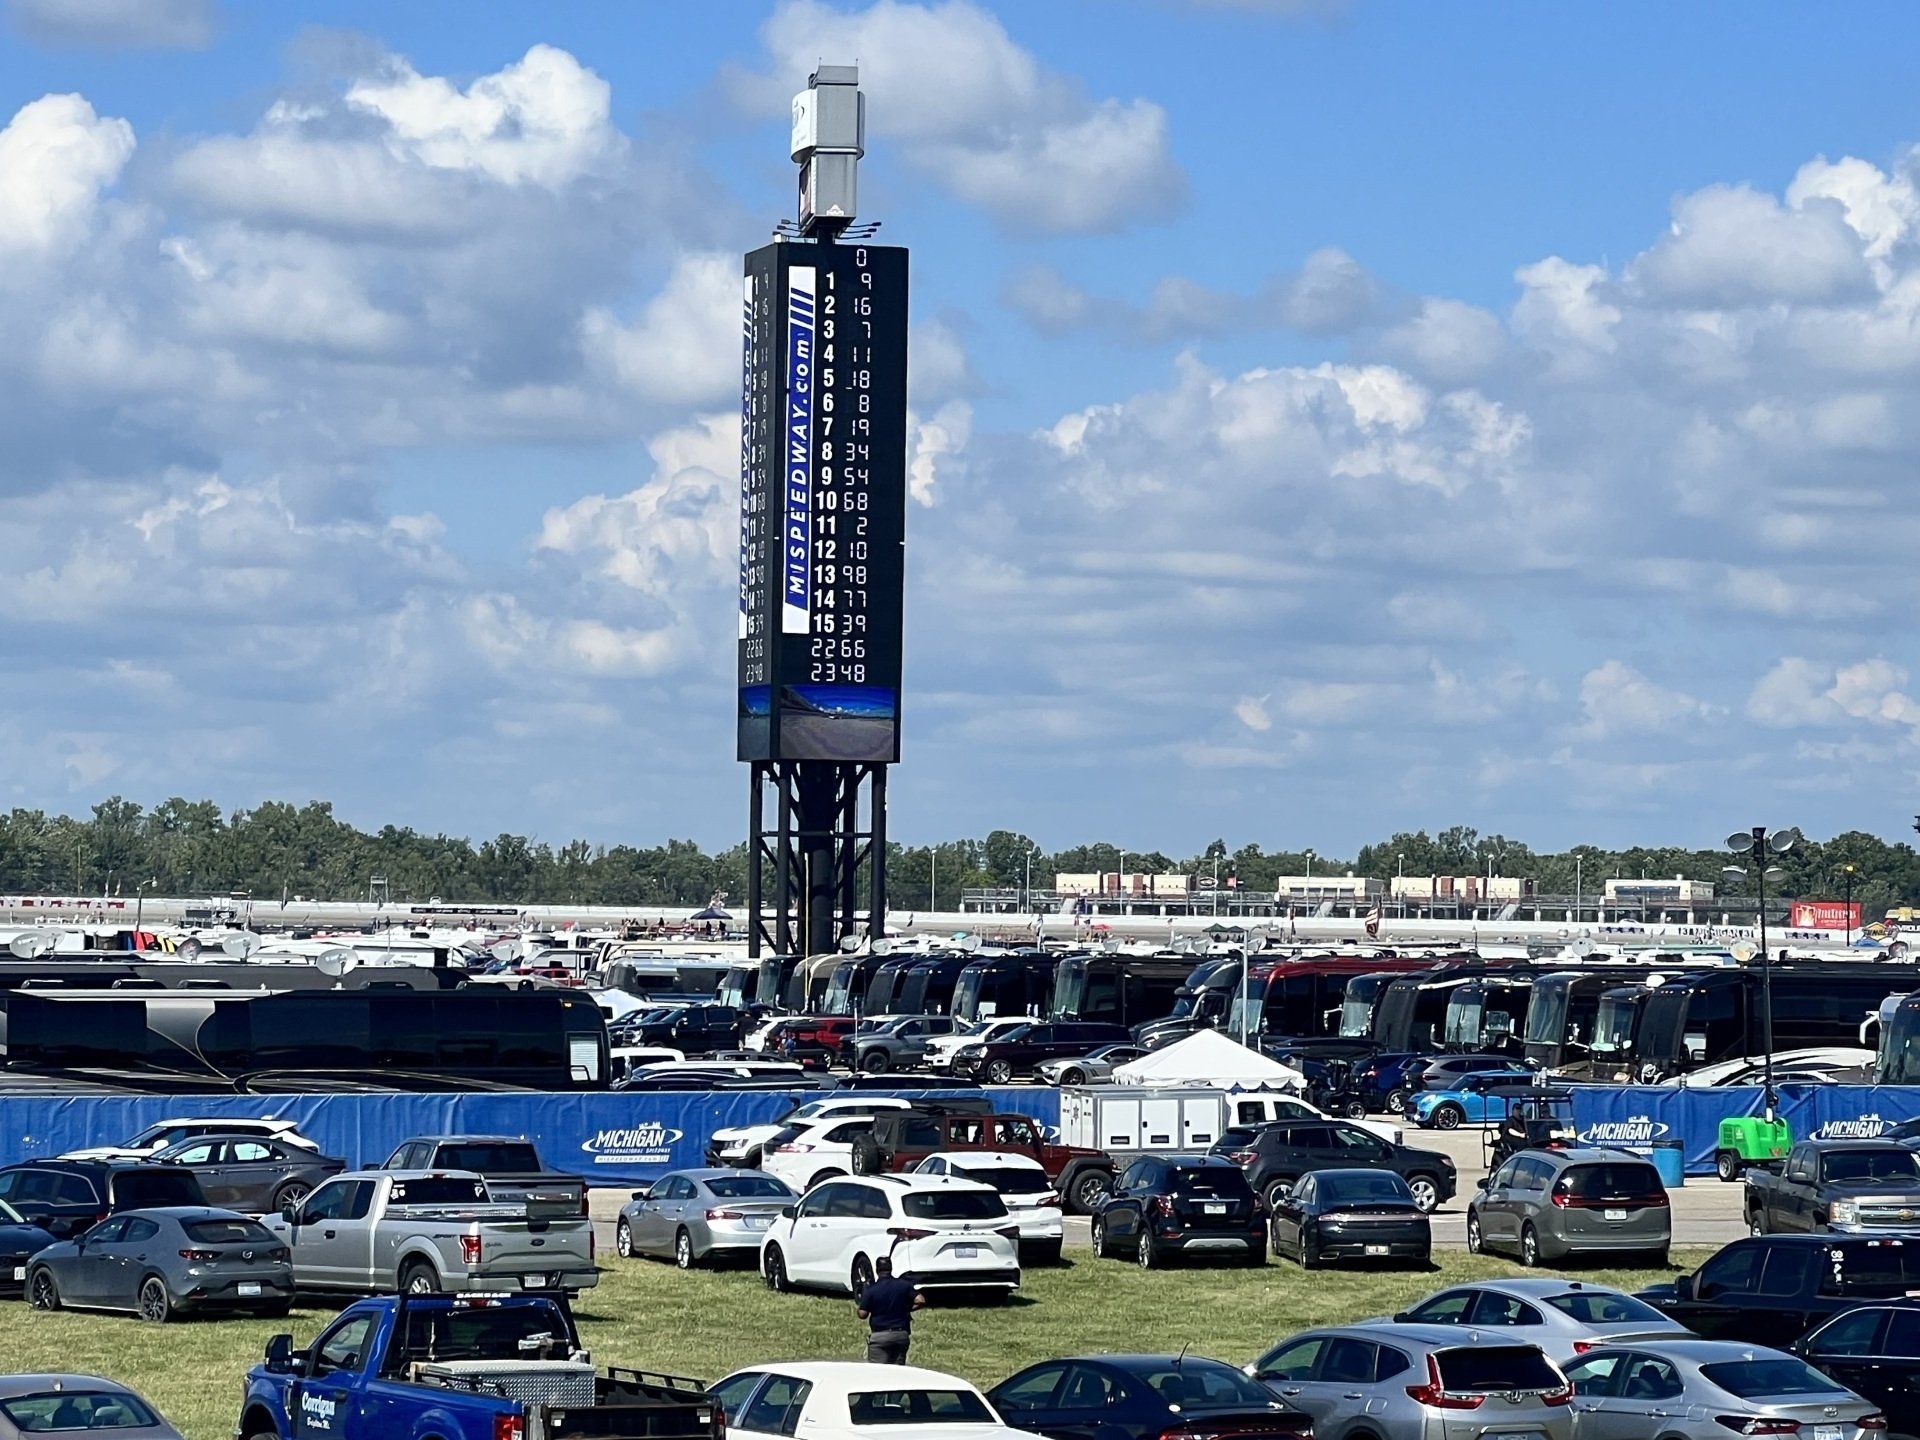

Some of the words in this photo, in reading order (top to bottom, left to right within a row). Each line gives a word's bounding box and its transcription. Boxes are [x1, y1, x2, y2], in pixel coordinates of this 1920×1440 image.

[856, 249, 867, 267] 0
[826, 272, 835, 290] 1
[861, 273, 872, 290] 9
[824, 296, 836, 314] 2
[854, 297, 872, 316] 16
[824, 320, 835, 338] 3
[862, 322, 871, 339] 7
[824, 344, 834, 362] 4
[854, 346, 871, 363] 11
[824, 368, 834, 387] 5
[853, 370, 870, 389] 18
[822, 393, 834, 412] 6
[858, 394, 870, 413] 8
[822, 418, 833, 436] 7
[852, 419, 869, 436] 19
[822, 442, 833, 460] 8
[846, 442, 869, 461] 34
[789, 339, 809, 595] MISPEEDWAY.com
[821, 466, 832, 485] 9
[844, 468, 869, 486] 54
[815, 491, 837, 510] 10
[843, 492, 868, 511] 68
[816, 516, 836, 534] 11
[856, 517, 868, 535] 2
[814, 540, 836, 559] 12
[850, 541, 867, 560] 10
[814, 564, 836, 584] 13
[842, 565, 867, 584] 98
[814, 589, 836, 608] 14
[843, 590, 867, 608] 77
[814, 614, 835, 633] 15
[843, 614, 866, 633] 39
[747, 639, 763, 658] 2266
[811, 638, 865, 658] 2266
[746, 663, 763, 683] 2348
[811, 663, 865, 683] 2348
[595, 1129, 667, 1148] MICHIGAN
[1589, 1122, 1654, 1140] MICHIGAN
[1821, 1121, 1885, 1138] MICHIGAN
[302, 1391, 335, 1418] Corrigan
